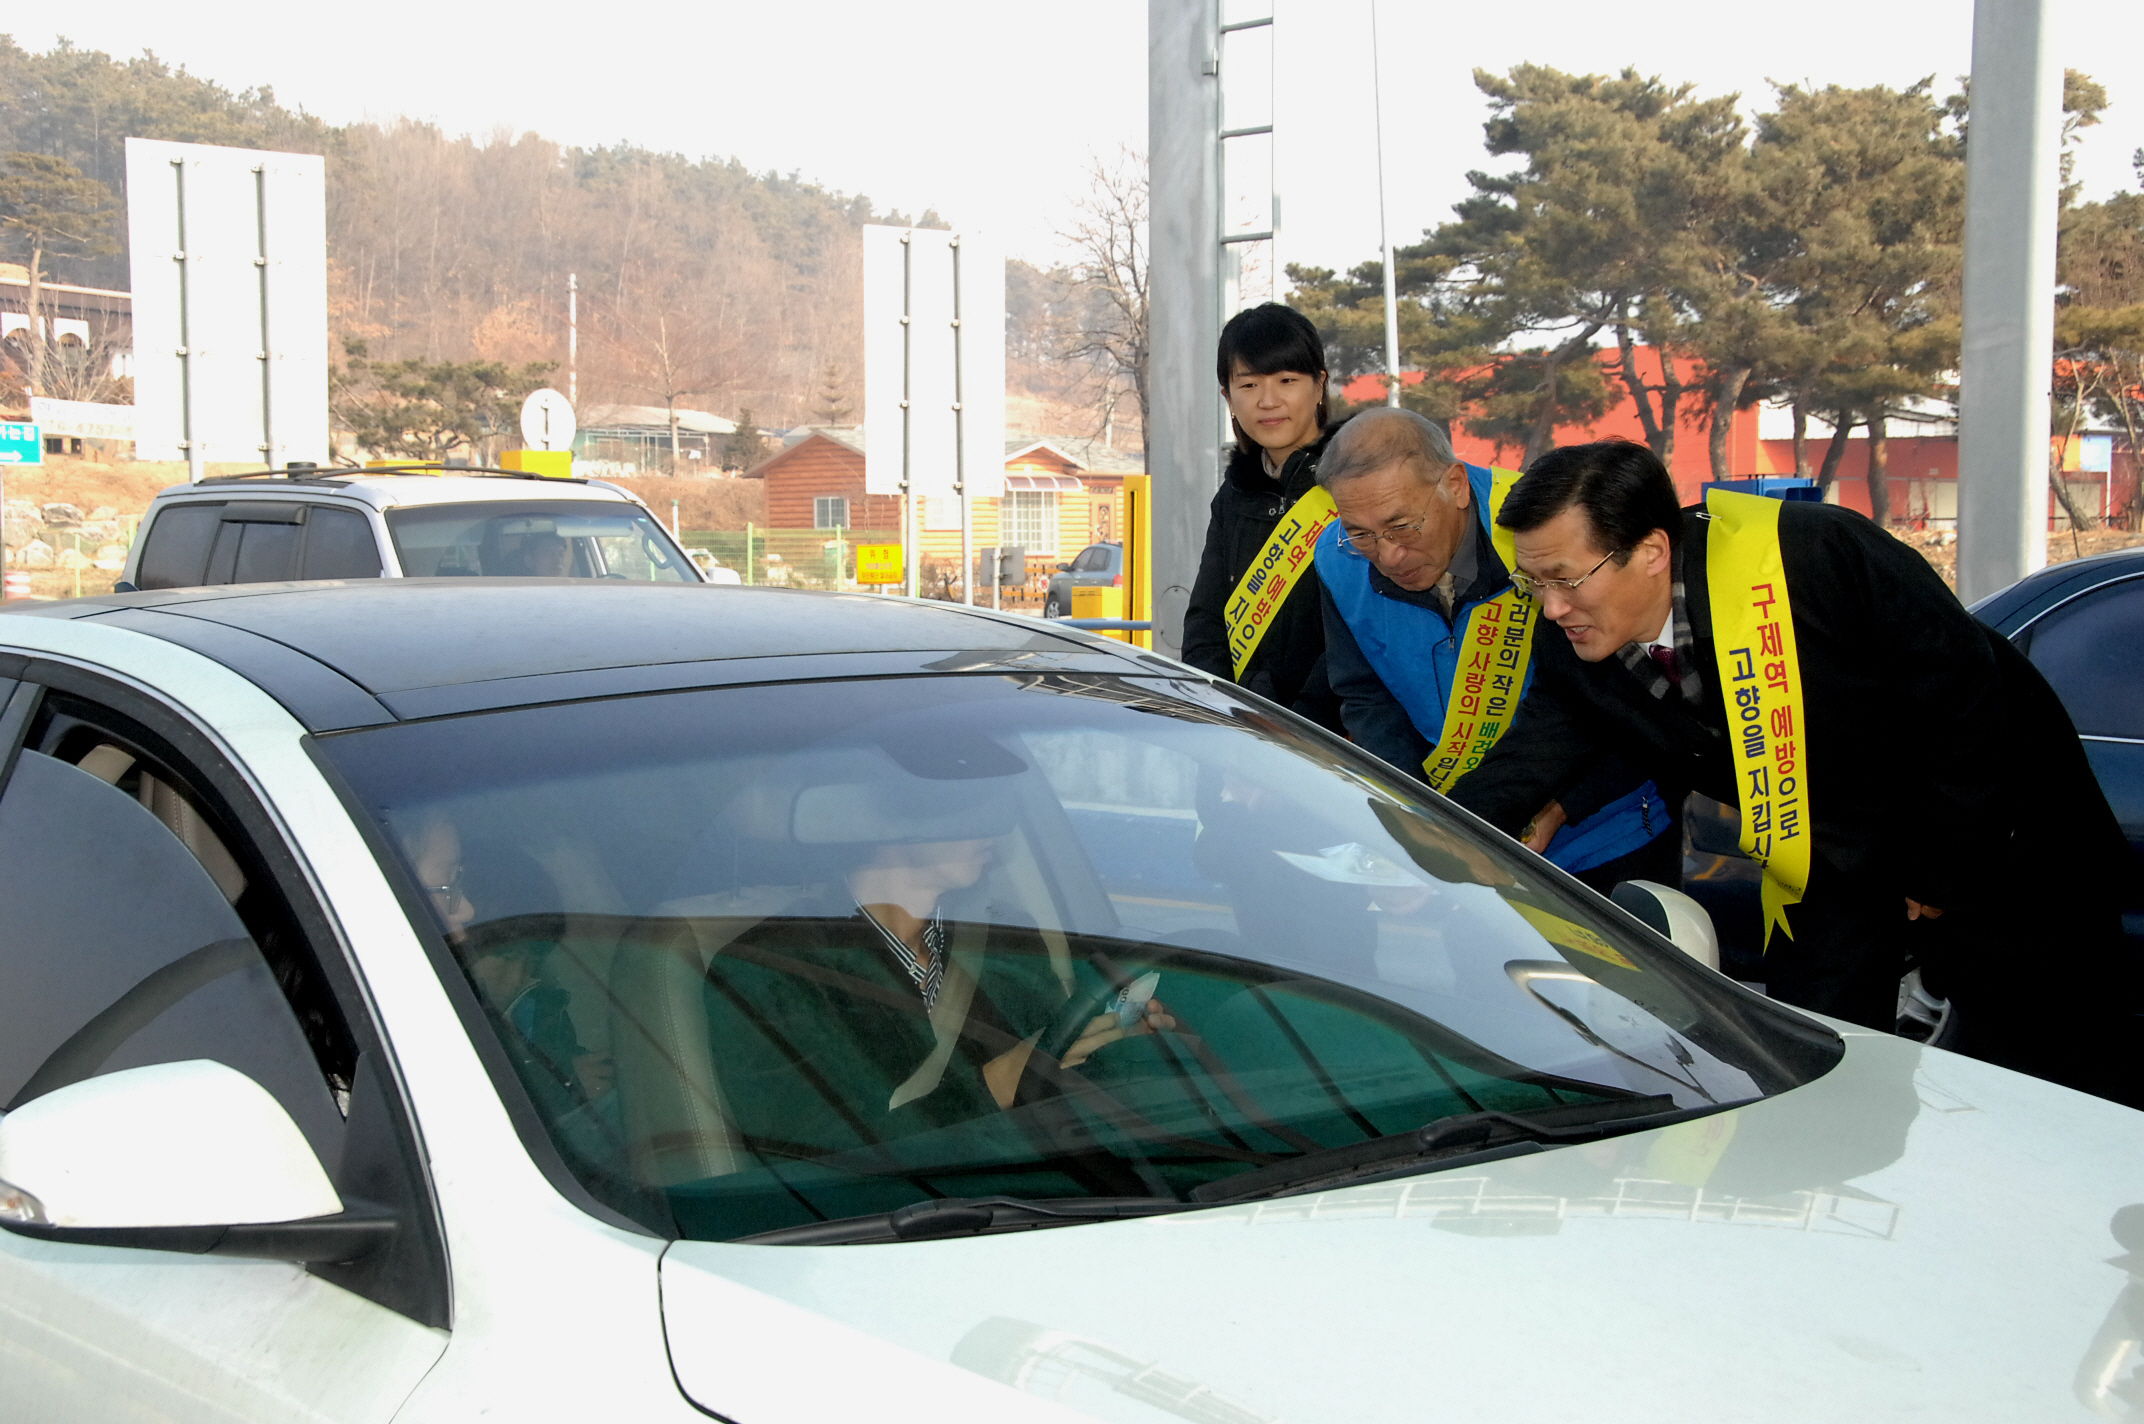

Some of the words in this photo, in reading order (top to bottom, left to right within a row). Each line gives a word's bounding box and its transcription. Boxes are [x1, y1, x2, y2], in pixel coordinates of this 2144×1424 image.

[1246, 518, 1303, 596] 고향을
[1476, 601, 1503, 647] 고향
[1457, 650, 1492, 717] 사랑의
[1485, 674, 1514, 717] 작은
[1728, 647, 1766, 759] 고향을
[1751, 583, 1789, 694] 구제역
[1770, 704, 1801, 842] 예방으로
